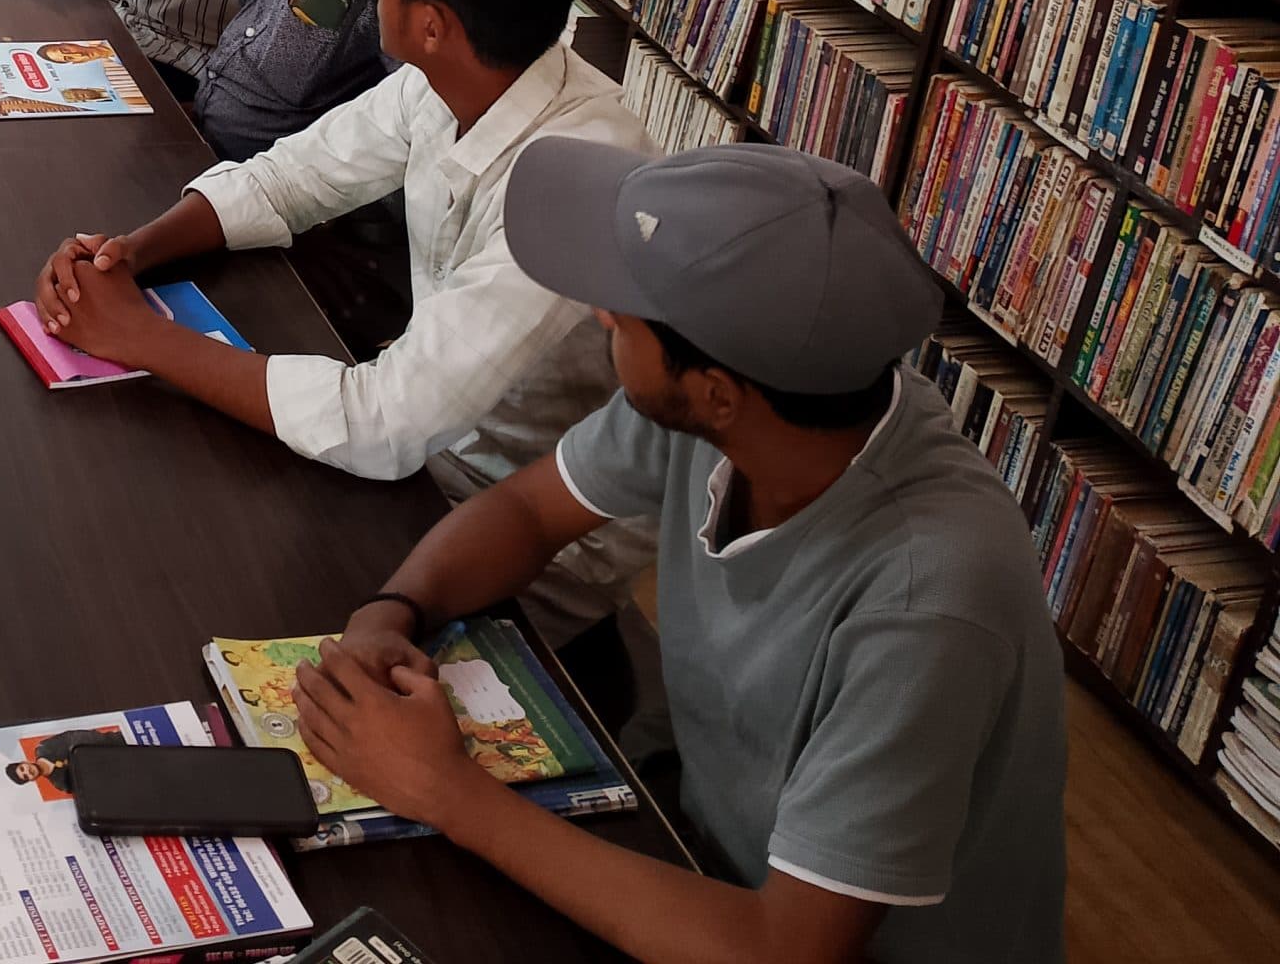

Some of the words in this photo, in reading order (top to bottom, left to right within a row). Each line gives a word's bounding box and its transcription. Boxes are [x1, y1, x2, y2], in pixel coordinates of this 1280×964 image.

[1052, 164, 1072, 198] CTET
[1098, 195, 1114, 220] CTET
[1036, 321, 1055, 353] CTET
[66, 860, 96, 904] TRAINING
[21, 894, 46, 932] DIVISION
[87, 902, 117, 946] OLYMPIAD
[124, 885, 160, 941] FOUNDATION
[178, 893, 203, 937] FACILITIES
[39, 932, 55, 955] NEET
